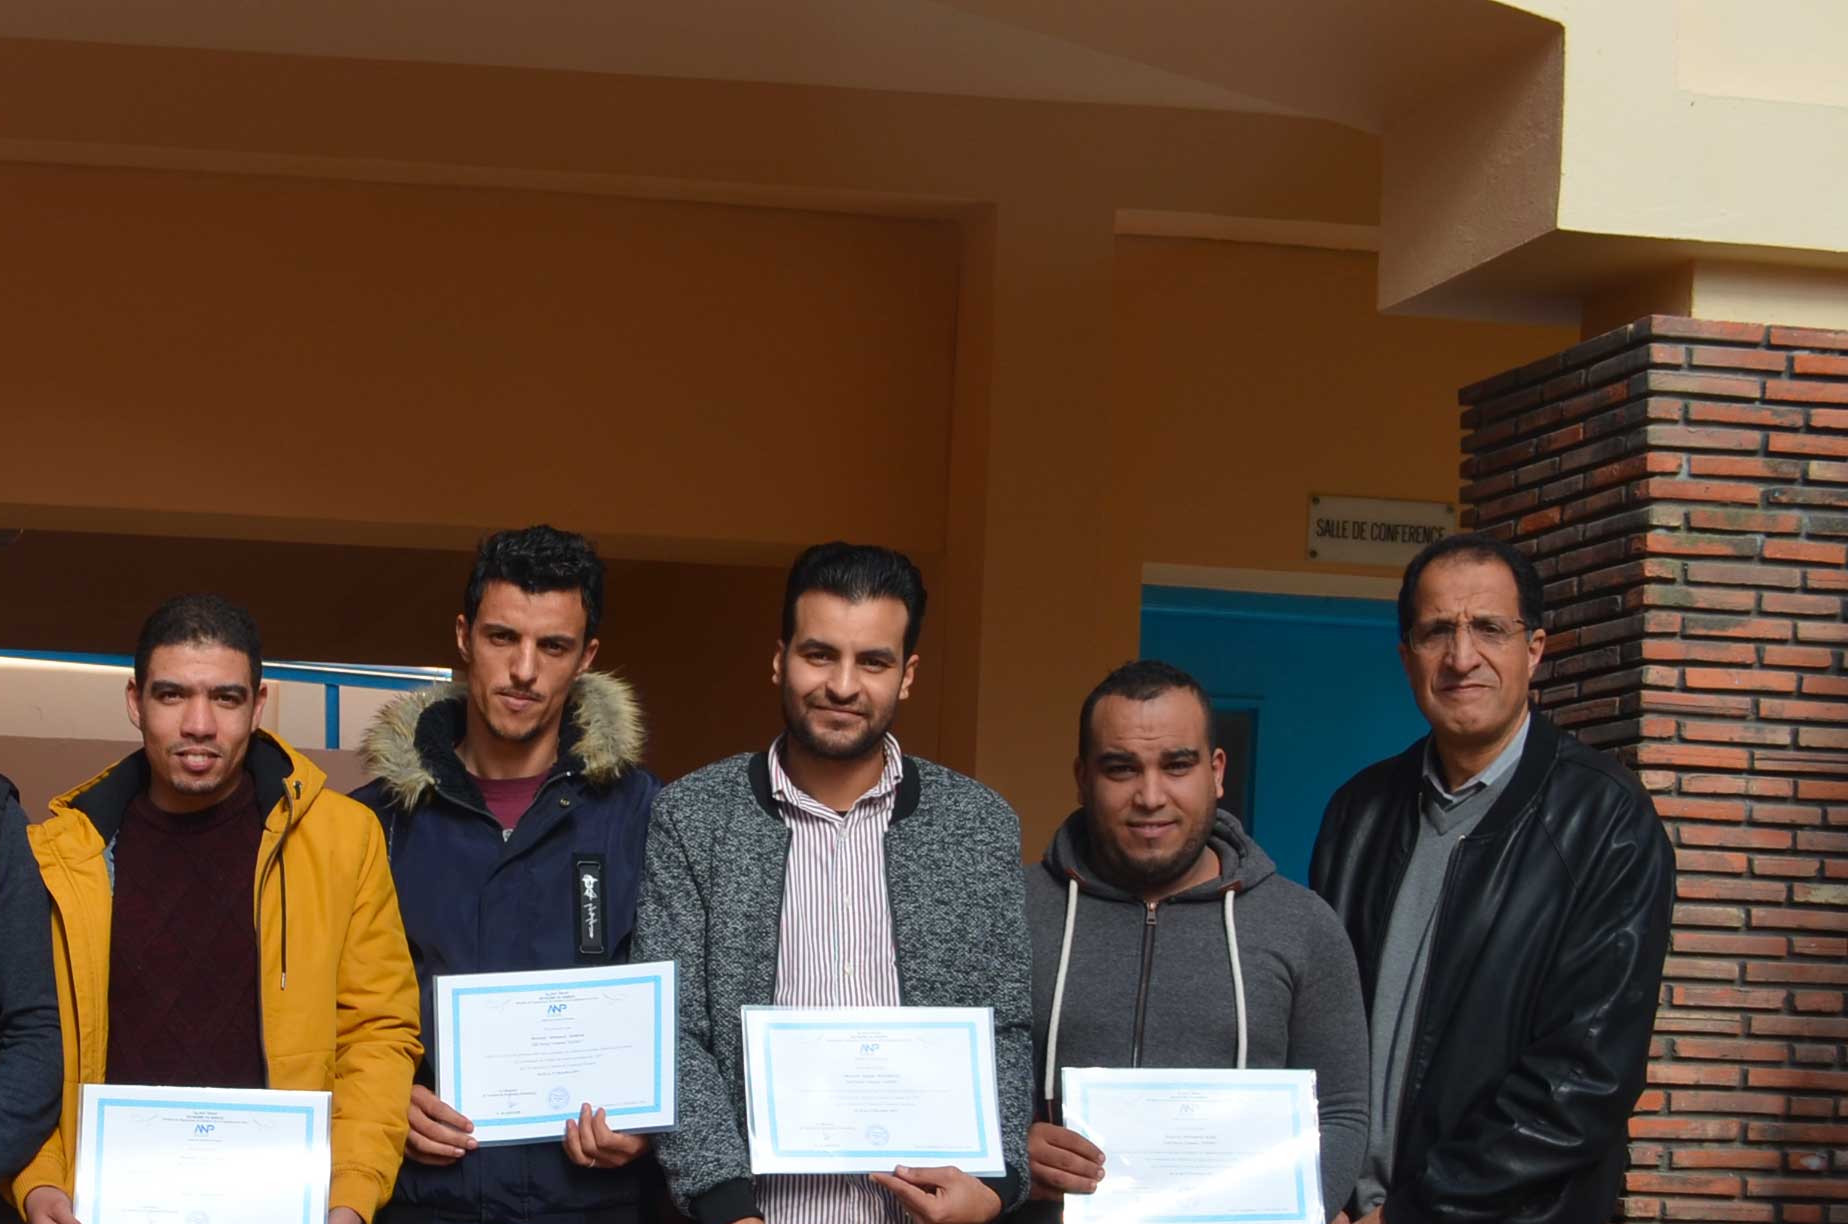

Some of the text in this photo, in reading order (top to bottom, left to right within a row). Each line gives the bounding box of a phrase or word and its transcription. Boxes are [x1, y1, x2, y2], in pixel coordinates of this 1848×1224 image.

[1316, 518, 1446, 544] SALLE DE CONFERENCE
